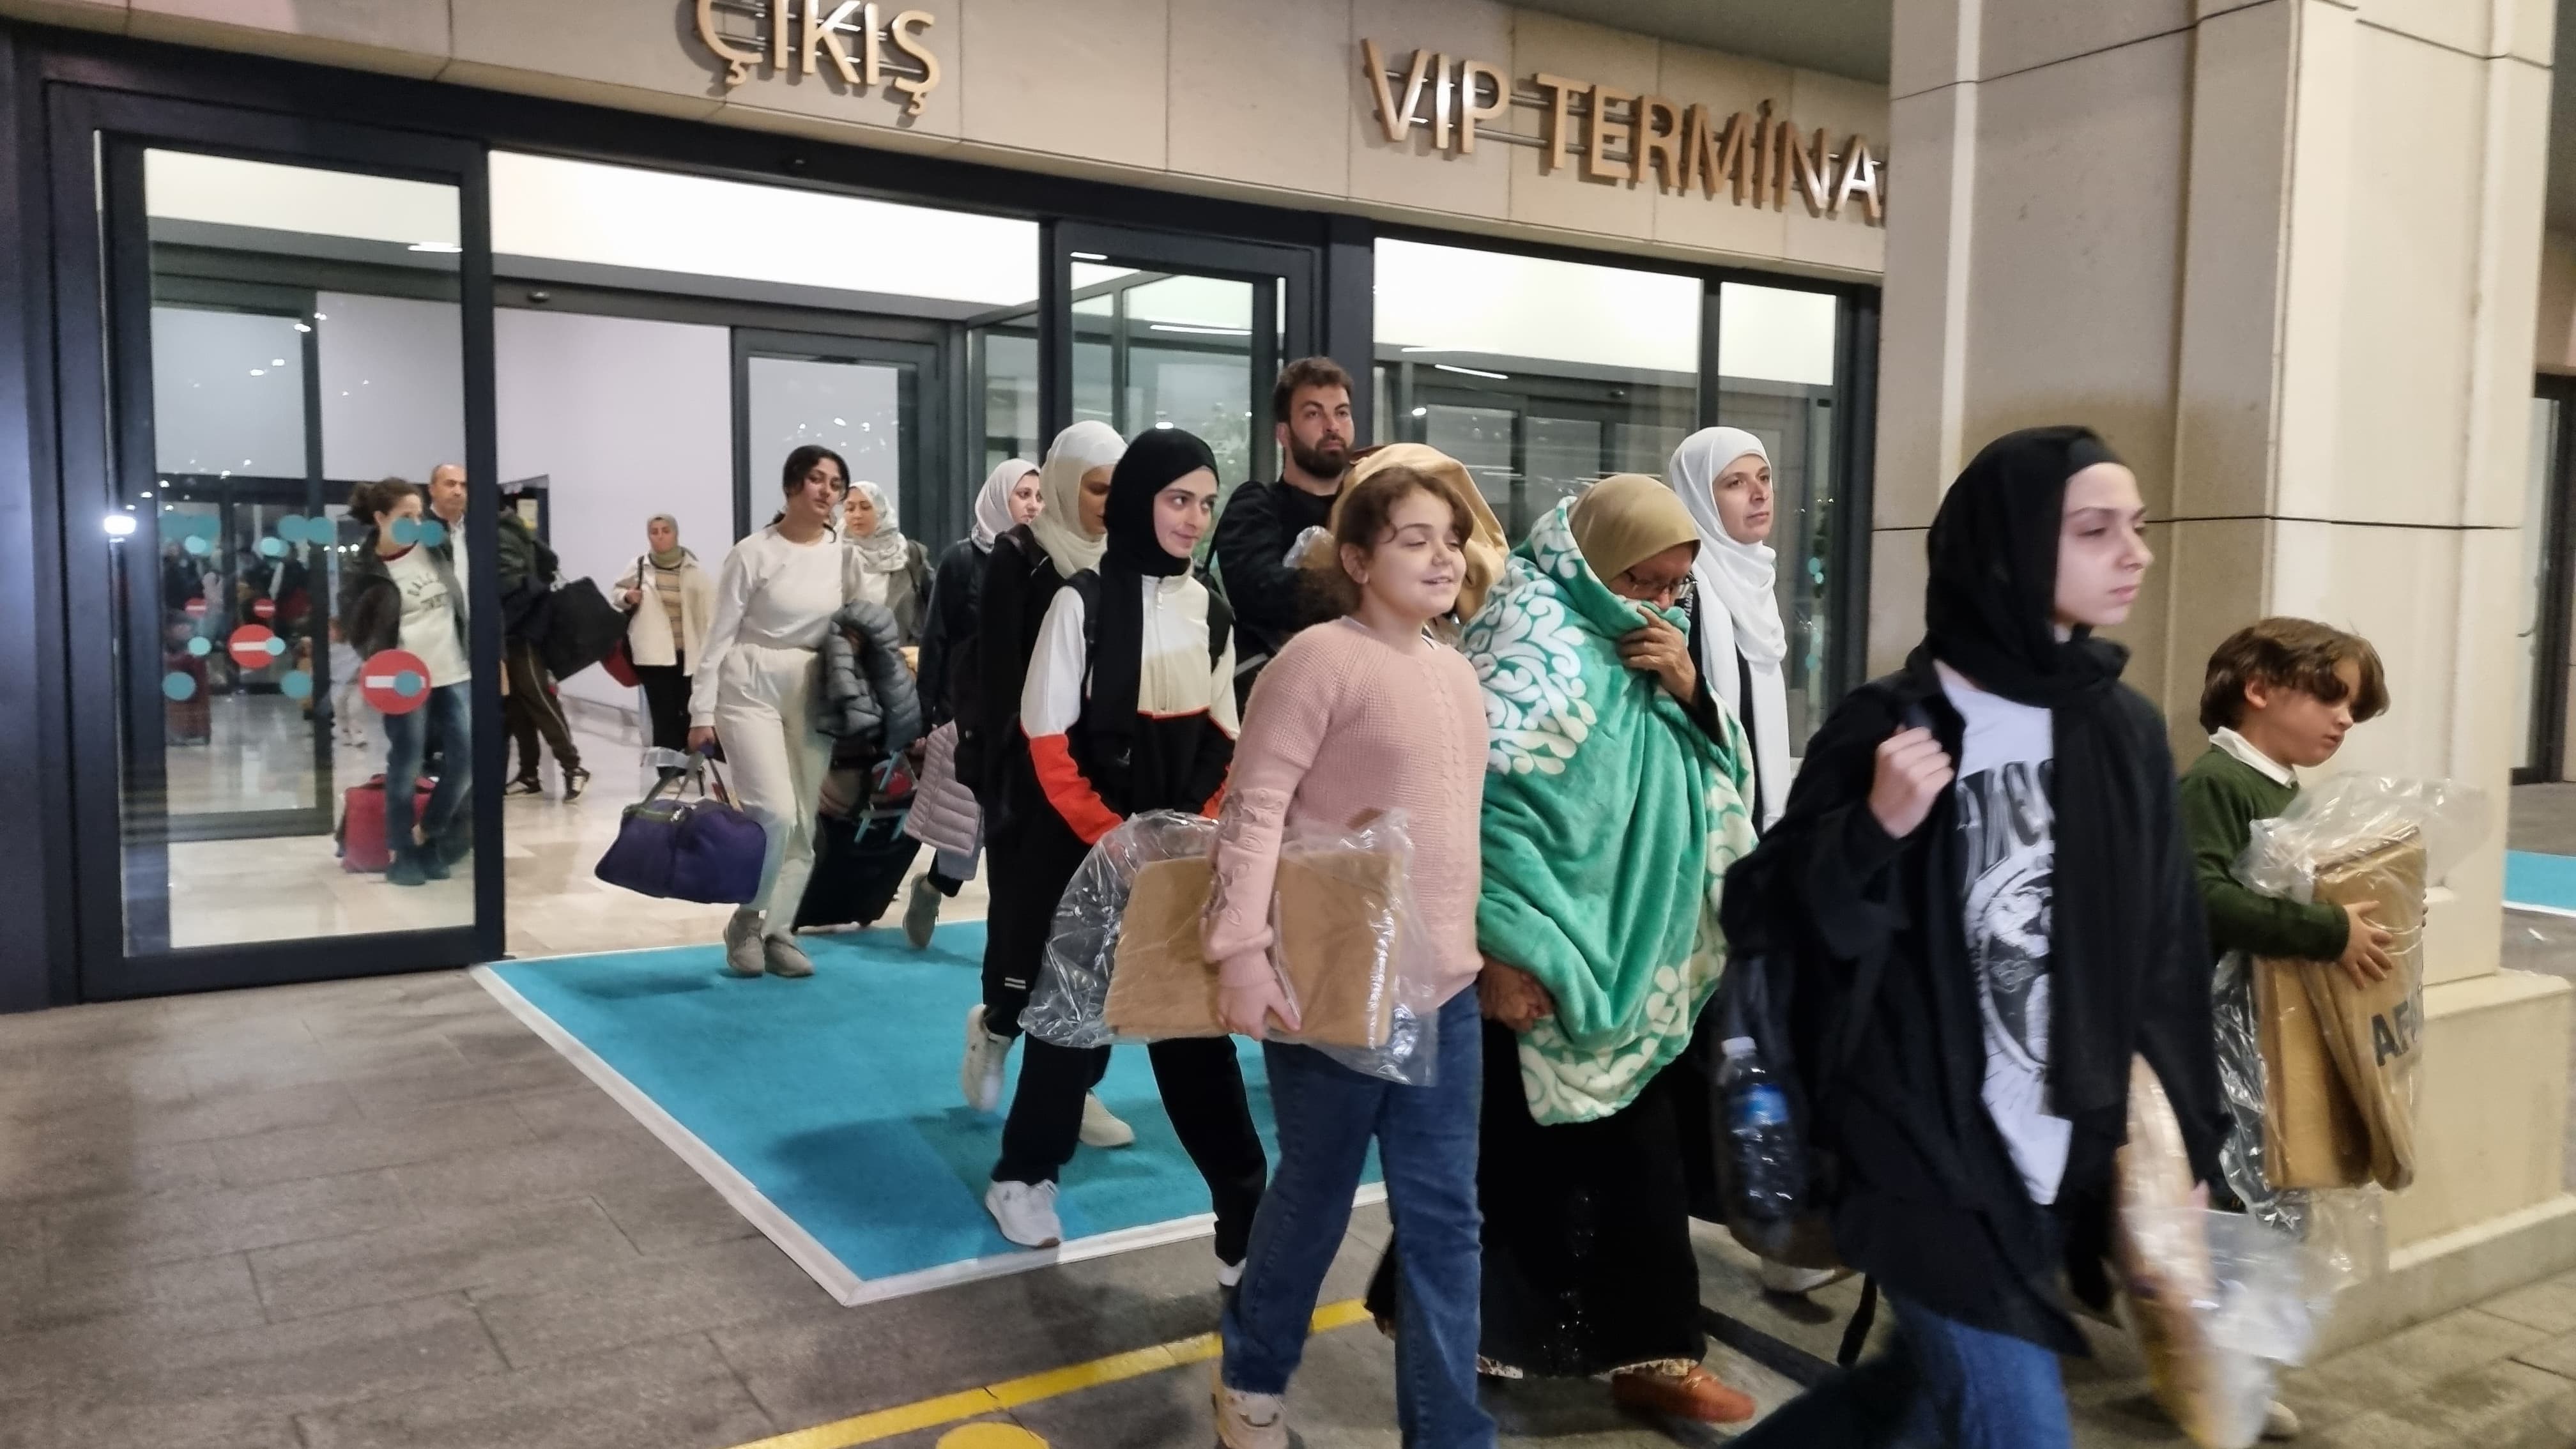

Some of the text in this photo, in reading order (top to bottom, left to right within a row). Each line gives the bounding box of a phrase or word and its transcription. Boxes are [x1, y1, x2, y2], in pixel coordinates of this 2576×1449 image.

[696, 0, 940, 116] ÇIKIŞ
[1361, 38, 1885, 224] VIP TERMİNA
[2371, 1000, 2417, 1068] AF
